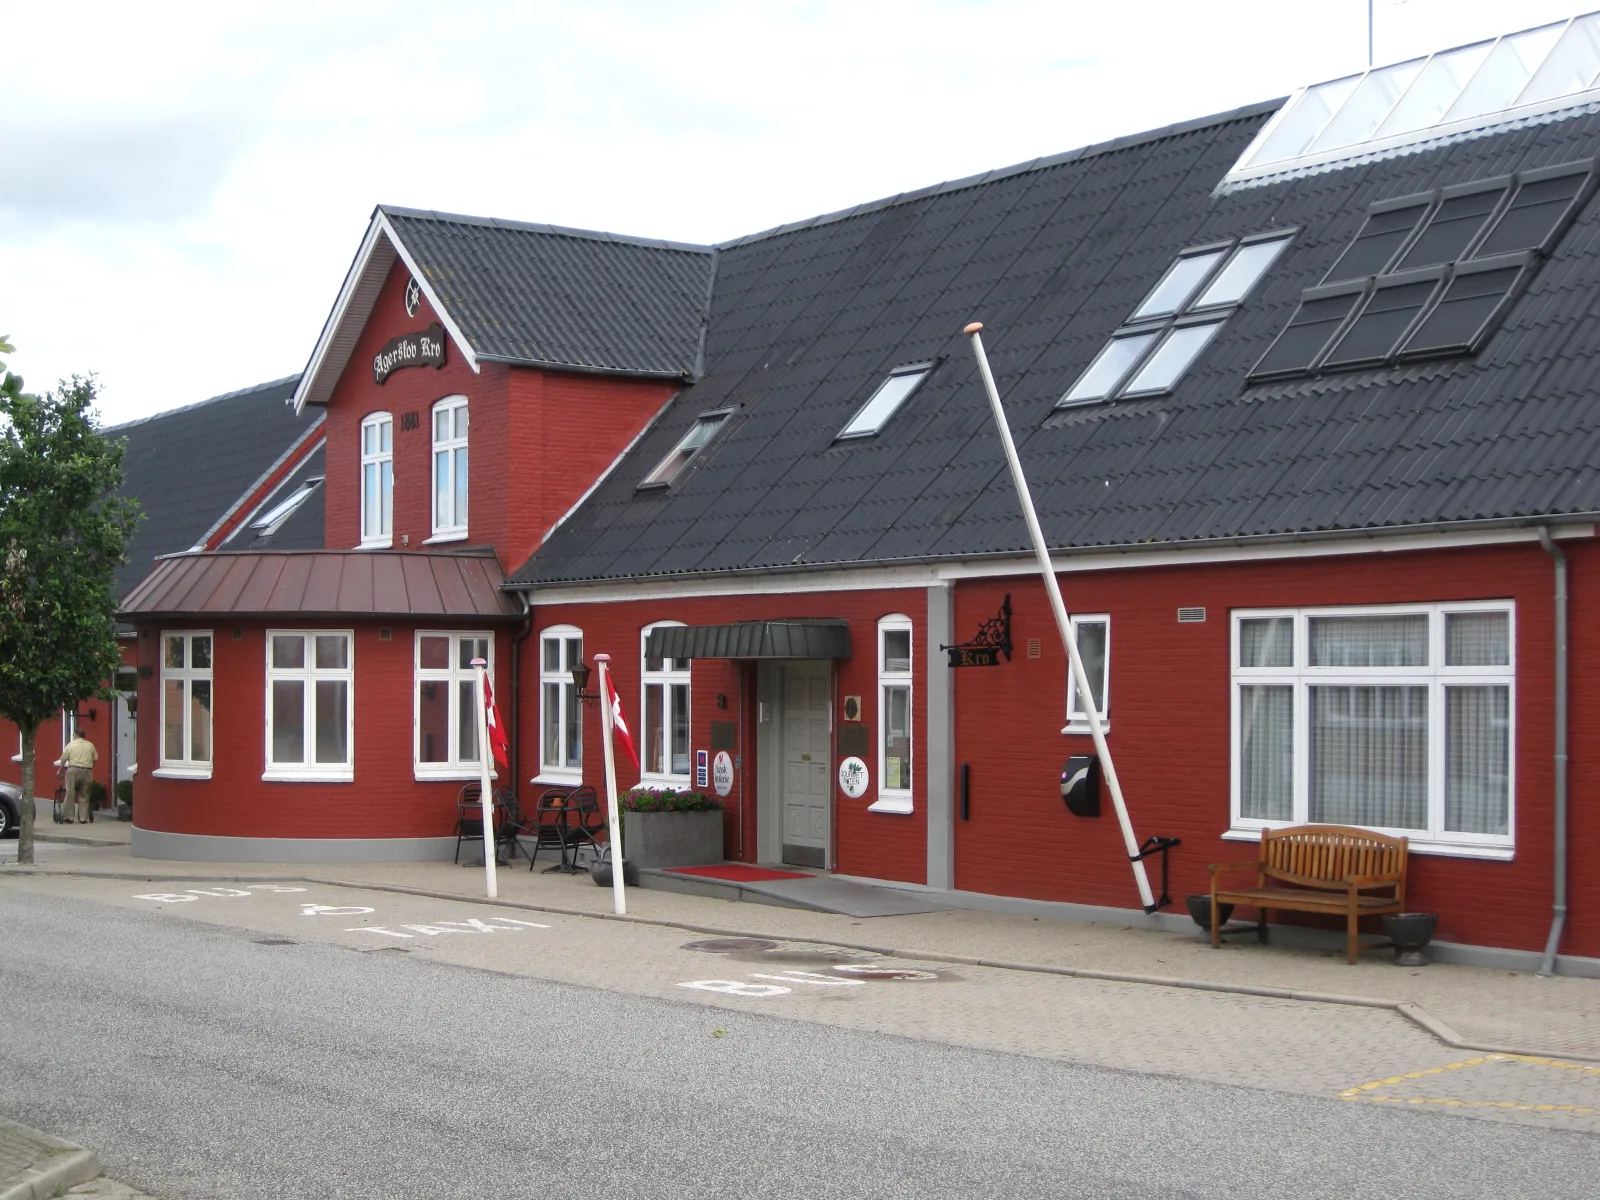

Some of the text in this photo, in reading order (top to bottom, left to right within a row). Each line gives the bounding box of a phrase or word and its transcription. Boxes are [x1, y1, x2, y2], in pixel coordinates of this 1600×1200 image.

[374, 337, 440, 379] Agerskov Kro
[960, 650, 990, 666] Kro
[131, 884, 308, 904] BUS
[343, 917, 553, 938] TAXI
[675, 964, 939, 997] BUS
